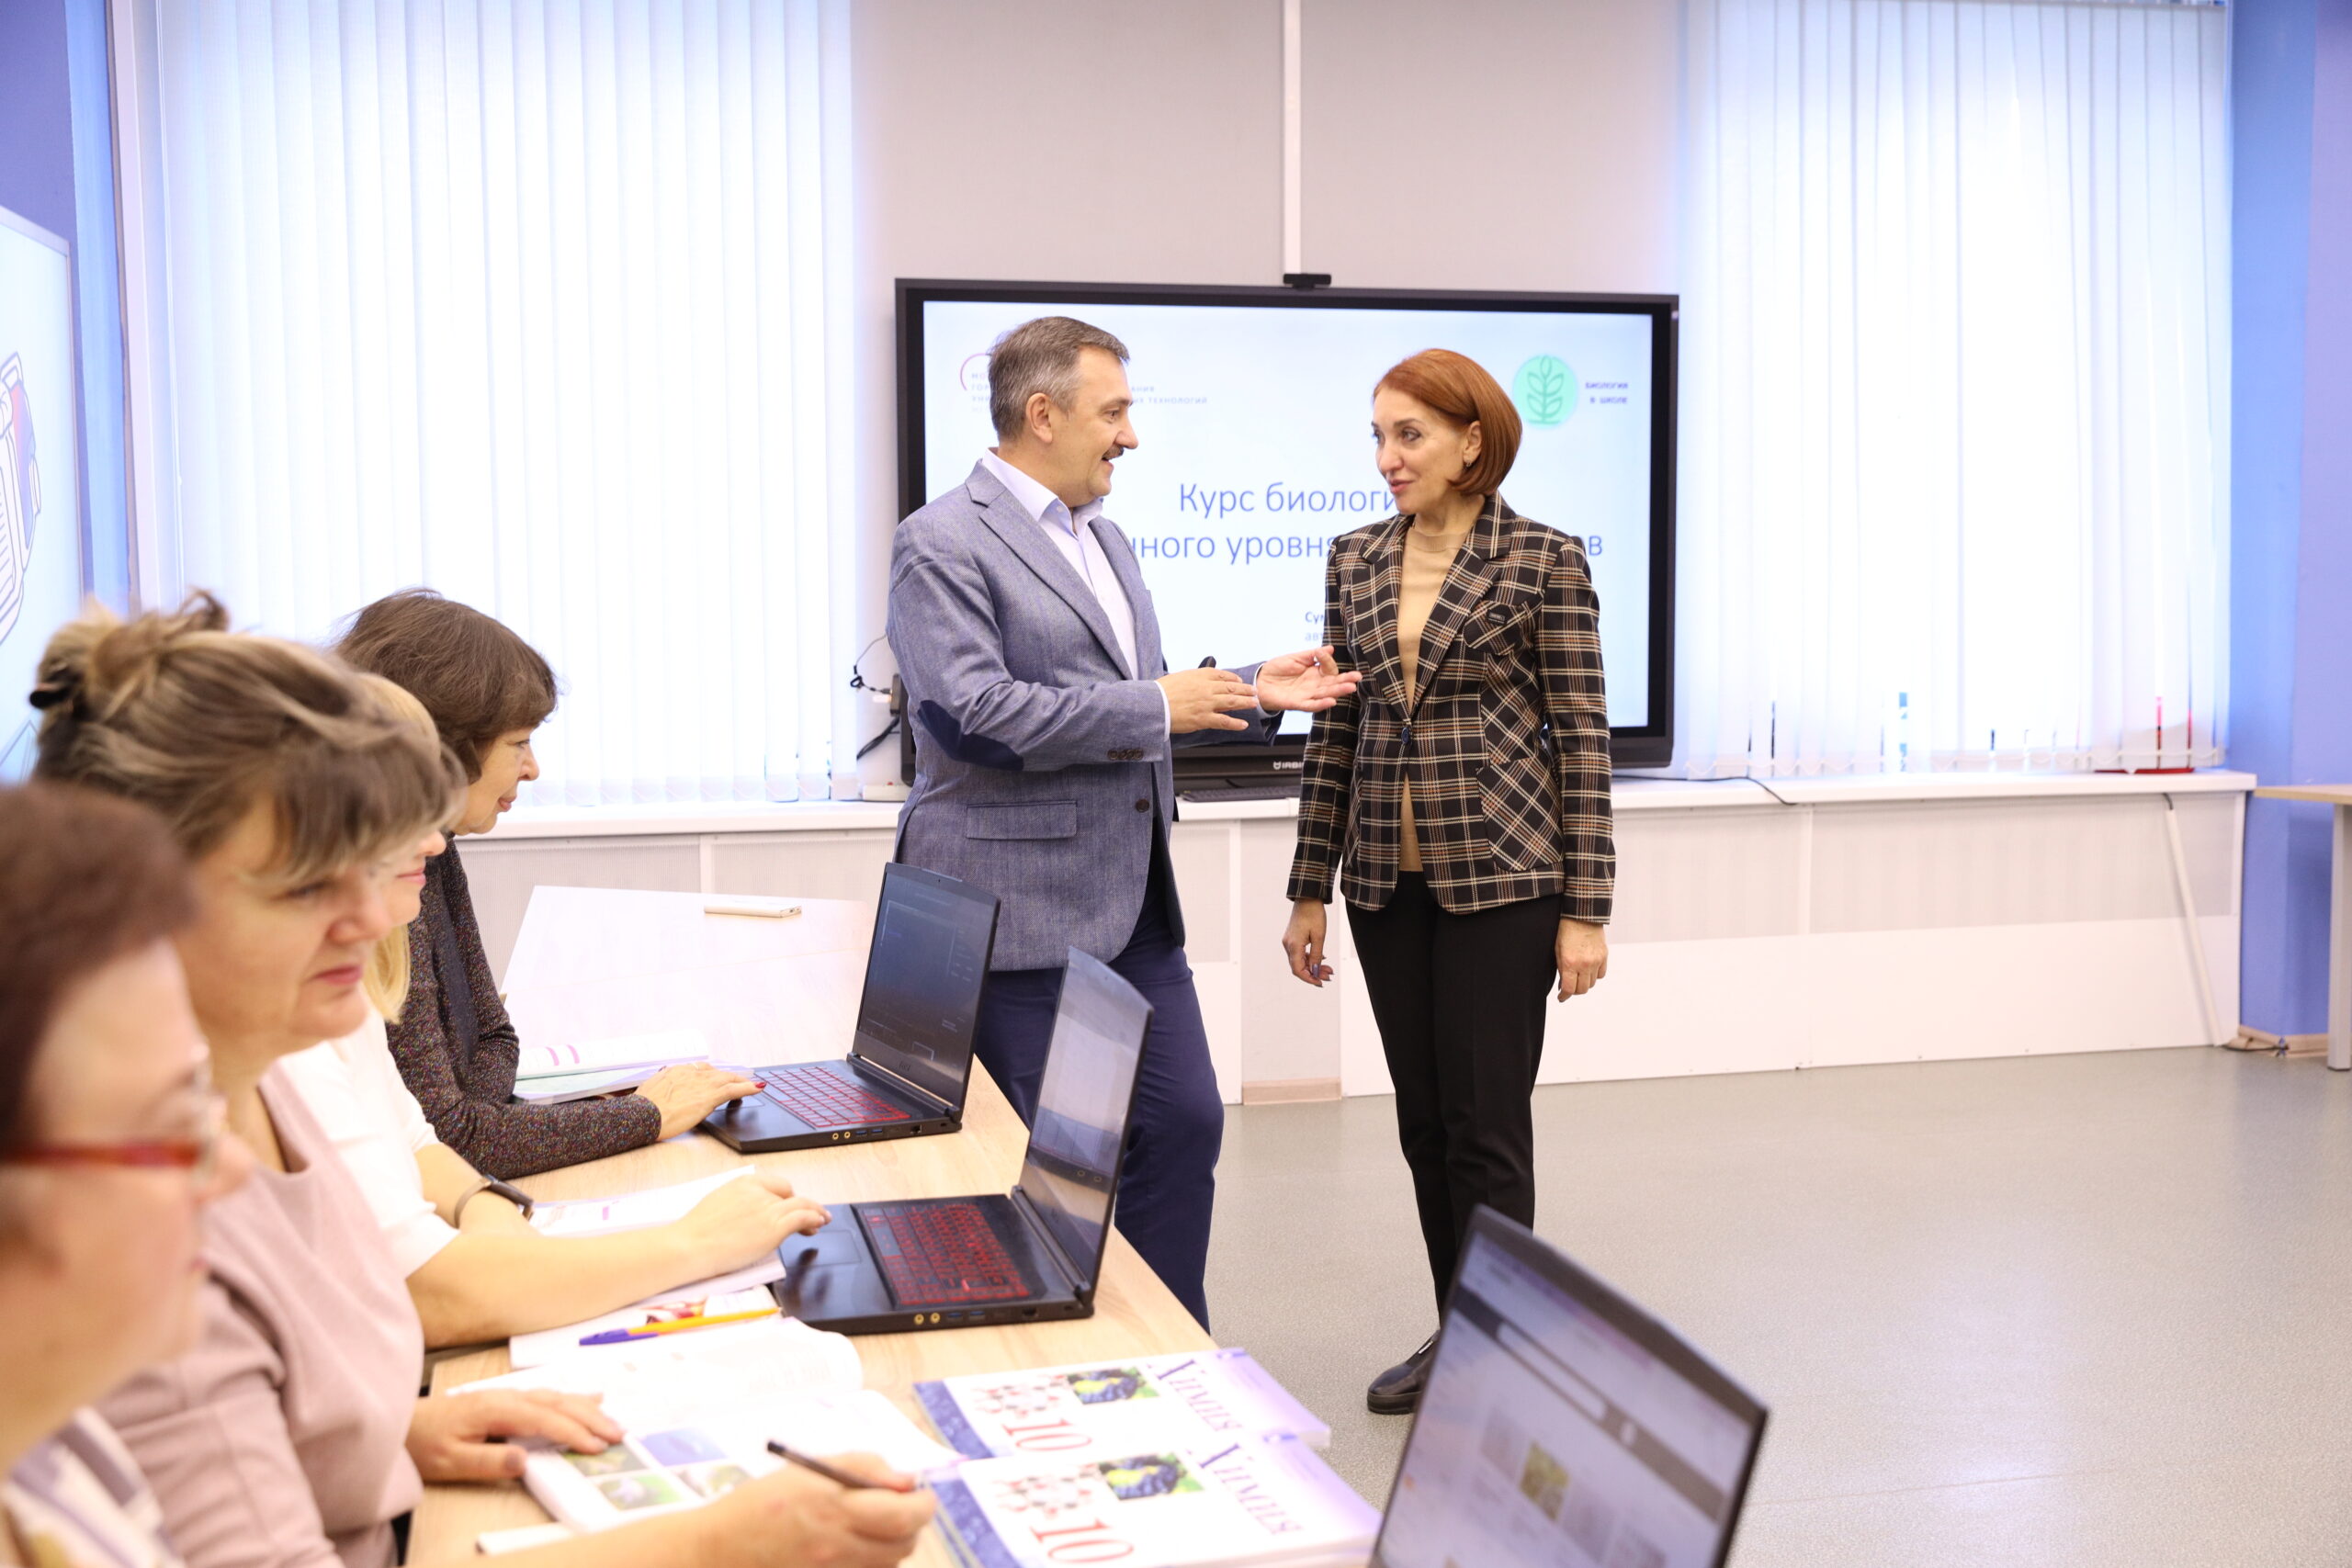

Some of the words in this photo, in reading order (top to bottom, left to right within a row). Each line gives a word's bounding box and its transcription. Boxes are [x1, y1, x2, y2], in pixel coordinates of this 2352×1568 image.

[1180, 483, 1255, 519] Курс
[1001, 1417, 1093, 1452] 10
[1028, 1517, 1136, 1563] 10
